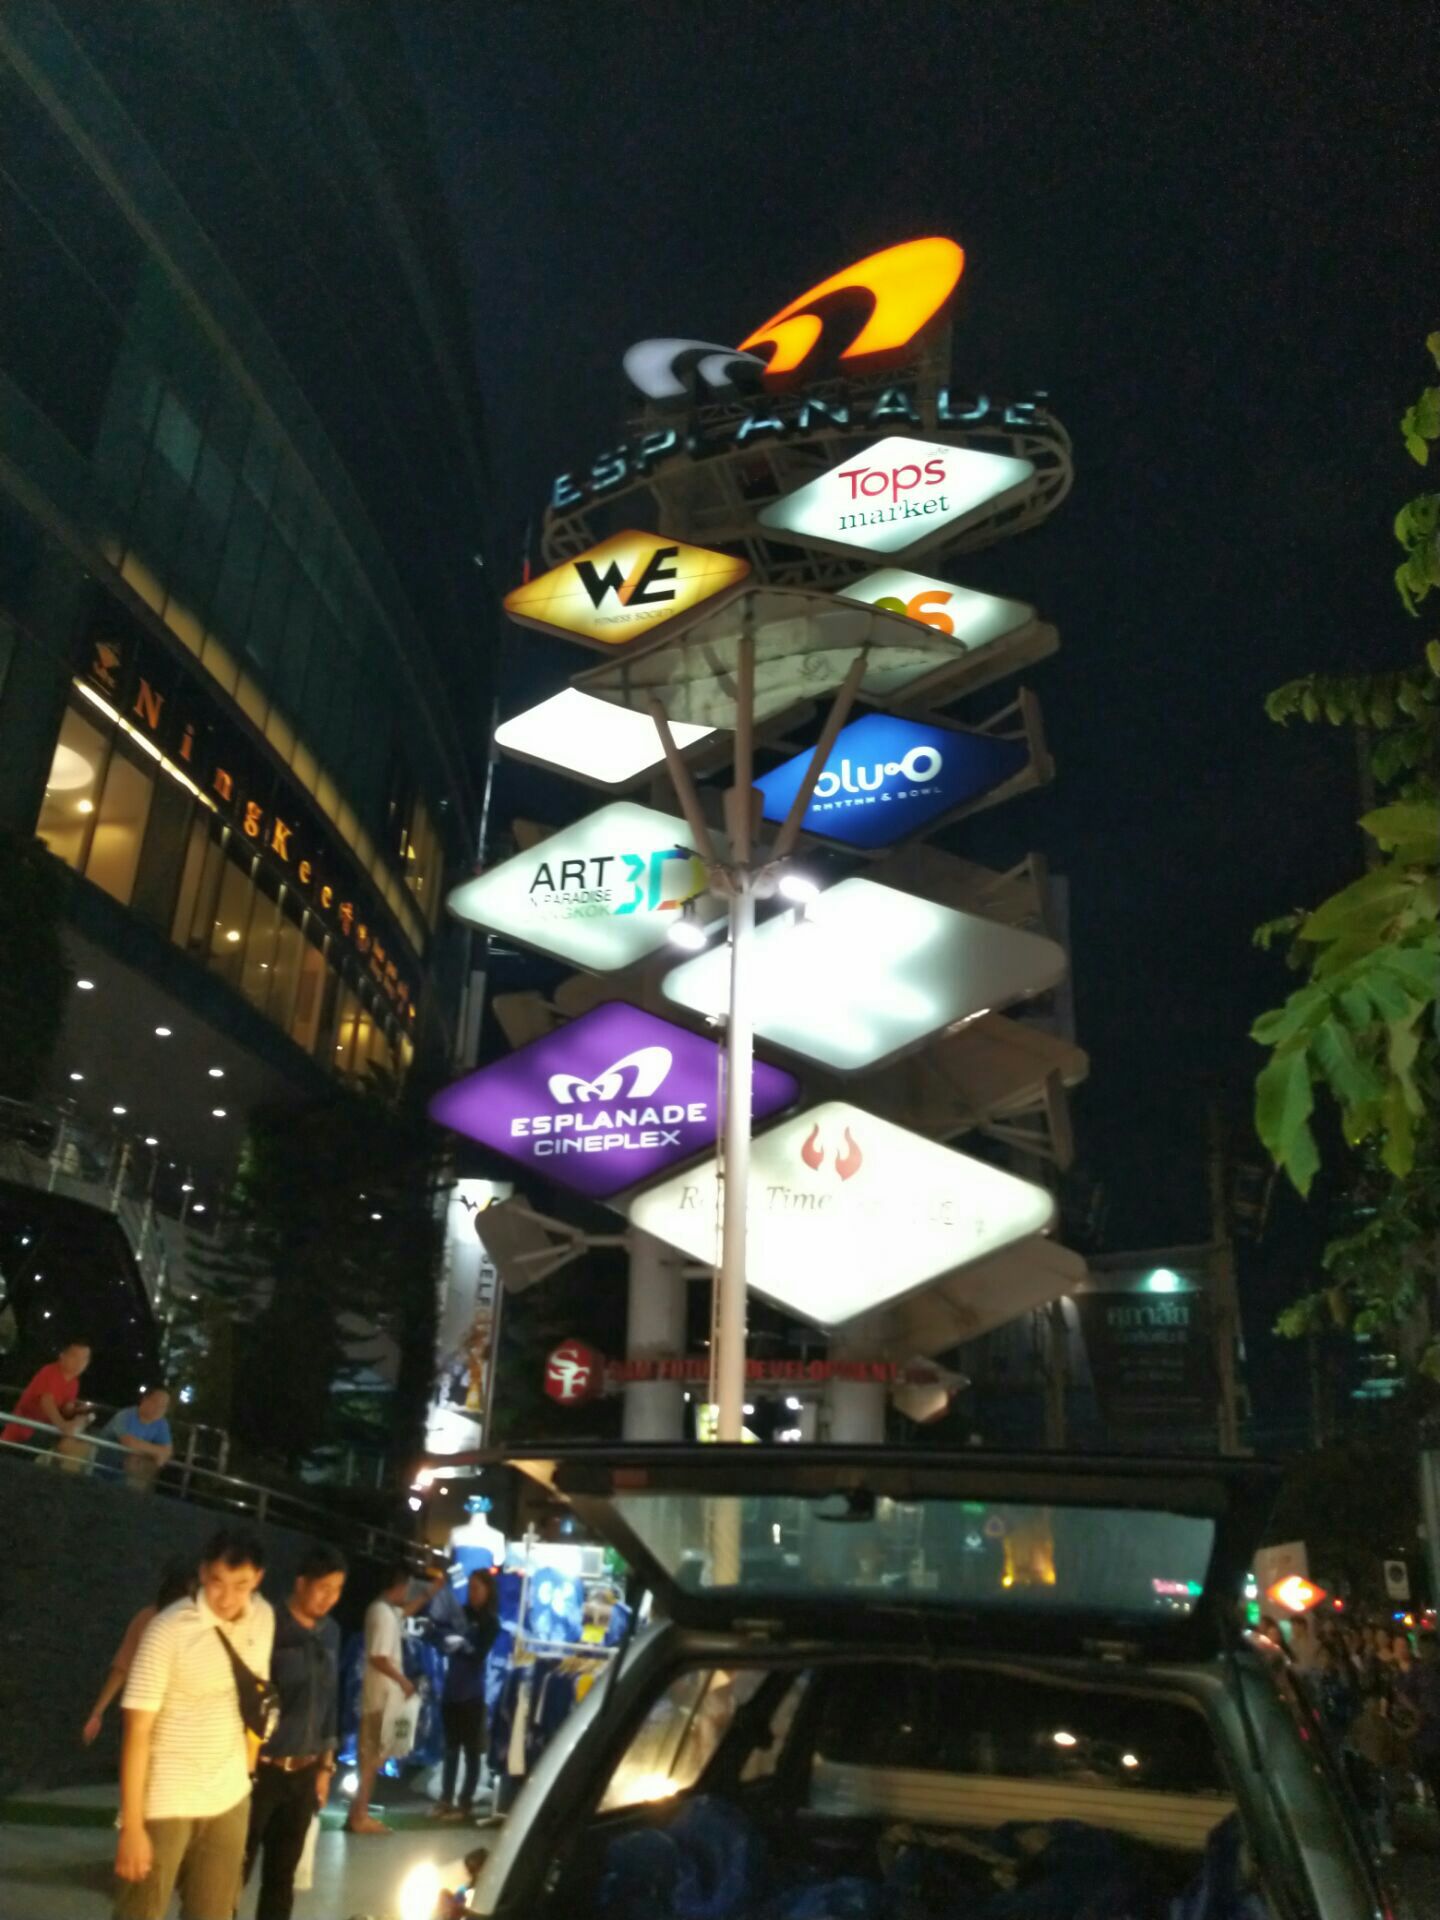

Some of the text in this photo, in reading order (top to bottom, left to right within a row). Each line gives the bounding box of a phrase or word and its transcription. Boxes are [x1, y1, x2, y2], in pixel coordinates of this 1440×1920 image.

[549, 387, 1051, 510] ESPLANADE
[837, 457, 947, 504] Tops
[837, 494, 951, 531] market
[572, 545, 681, 611] WE
[528, 855, 616, 895] ART
[510, 1102, 708, 1138] ESPLANADE
[533, 1129, 682, 1157] CINEPLEX
[766, 1184, 834, 1211] Time
[546, 1348, 590, 1398] SF
